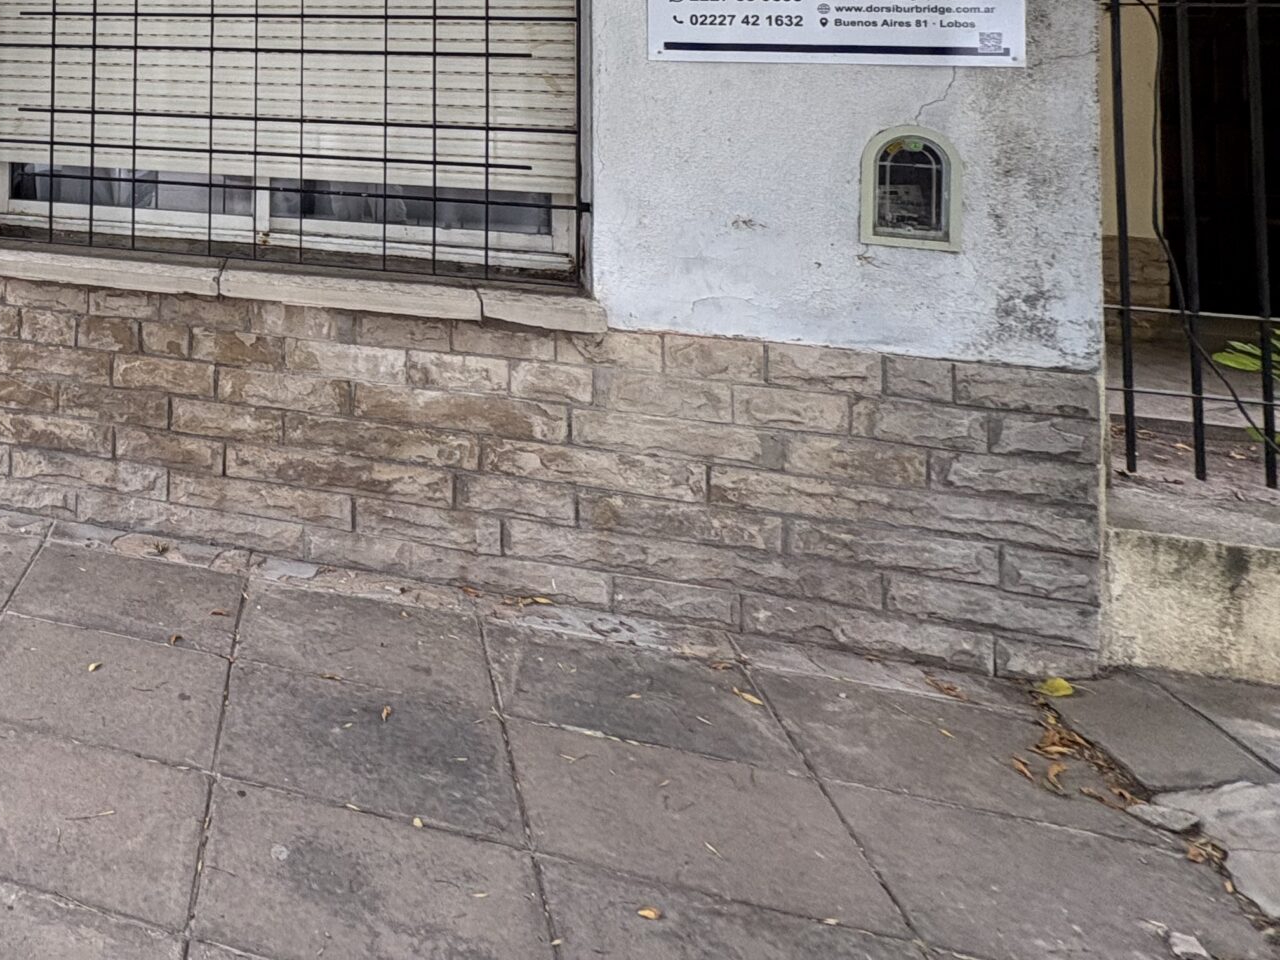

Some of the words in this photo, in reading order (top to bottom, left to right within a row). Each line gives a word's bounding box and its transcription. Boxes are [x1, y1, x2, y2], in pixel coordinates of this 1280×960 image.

[834, 5, 996, 15] www.dorsiburbridge.com.ar
[689, 14, 736, 26] 02227
[741, 14, 760, 26] 42
[765, 15, 804, 27] 1632
[834, 19, 878, 28] Buenos
[881, 19, 911, 28] Aires
[915, 19, 928, 28] 81
[939, 20, 976, 28] Lobos
